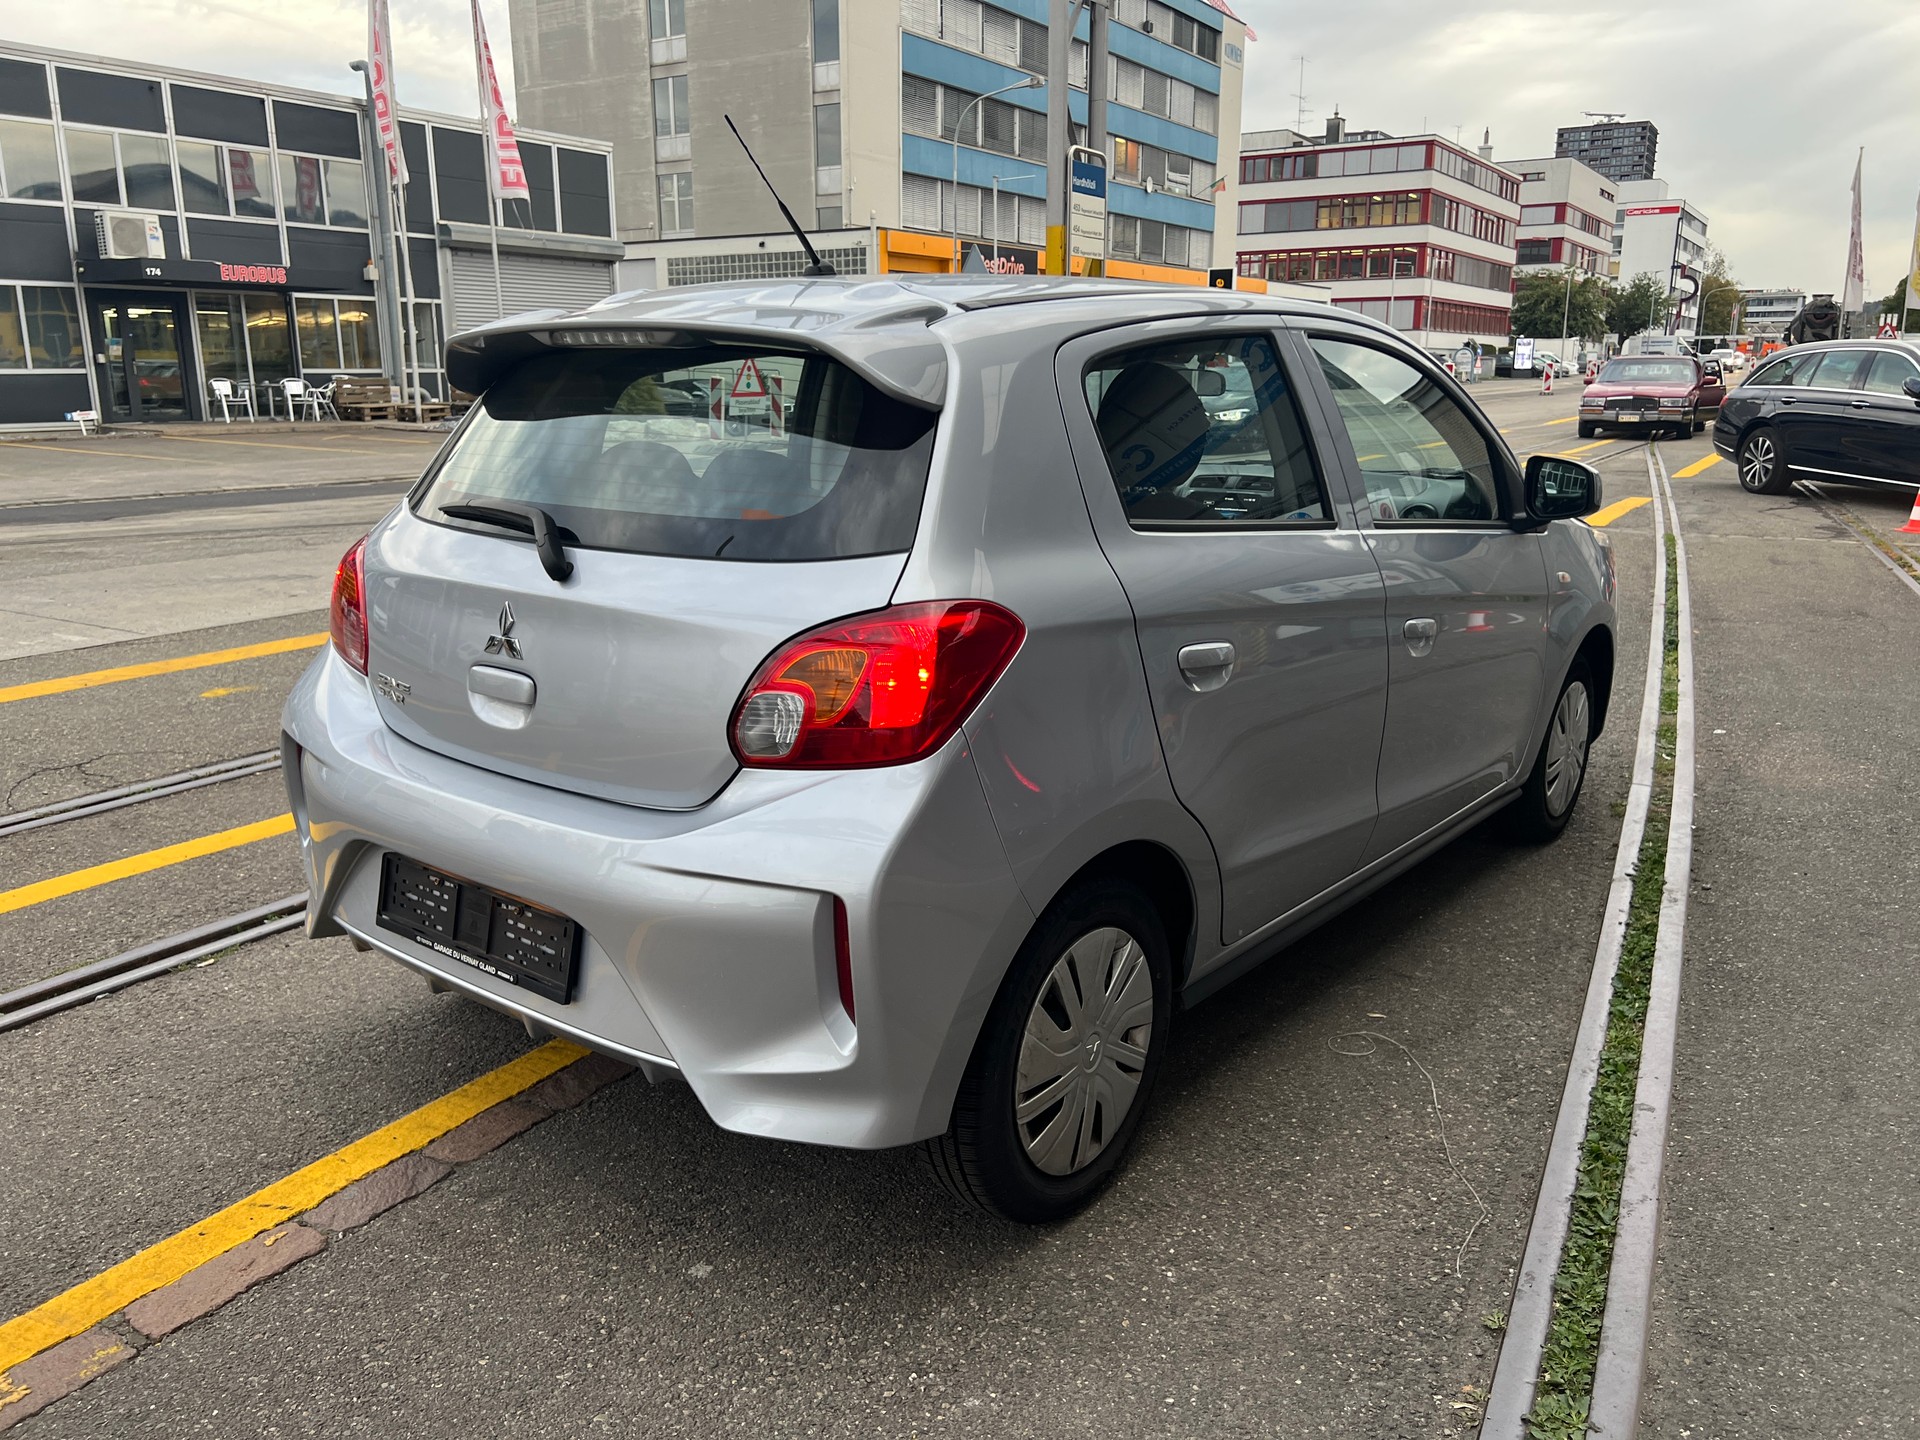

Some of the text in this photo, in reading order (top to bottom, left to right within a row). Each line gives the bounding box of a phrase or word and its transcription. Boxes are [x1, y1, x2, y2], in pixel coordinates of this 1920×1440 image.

[145, 267, 162, 276] 174
[220, 264, 287, 284] EUROBUS
[980, 255, 1025, 274] estDrive
[433, 942, 453, 956] GARAGE
[452, 950, 461, 960] DU
[460, 953, 479, 967] VERNAY
[478, 961, 497, 975] GLAND
